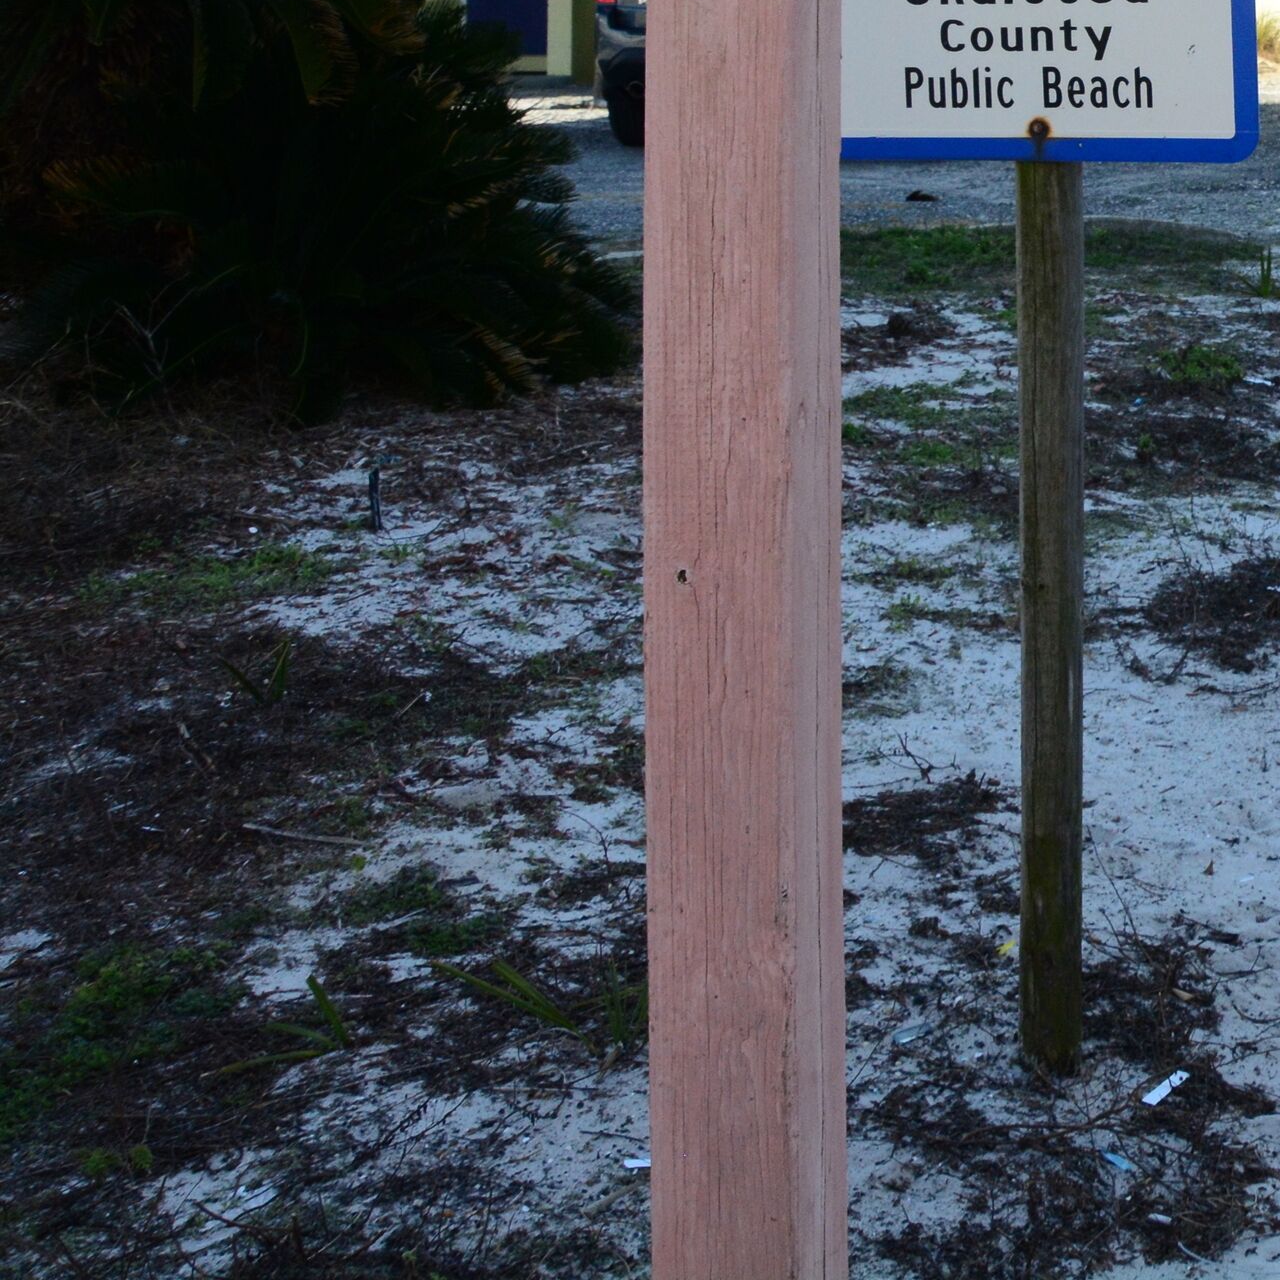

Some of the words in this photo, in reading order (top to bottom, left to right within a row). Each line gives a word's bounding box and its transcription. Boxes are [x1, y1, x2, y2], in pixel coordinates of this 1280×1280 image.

[940, 19, 1112, 60] County
[905, 66, 1015, 108] Public
[1042, 66, 1154, 108] Beach
